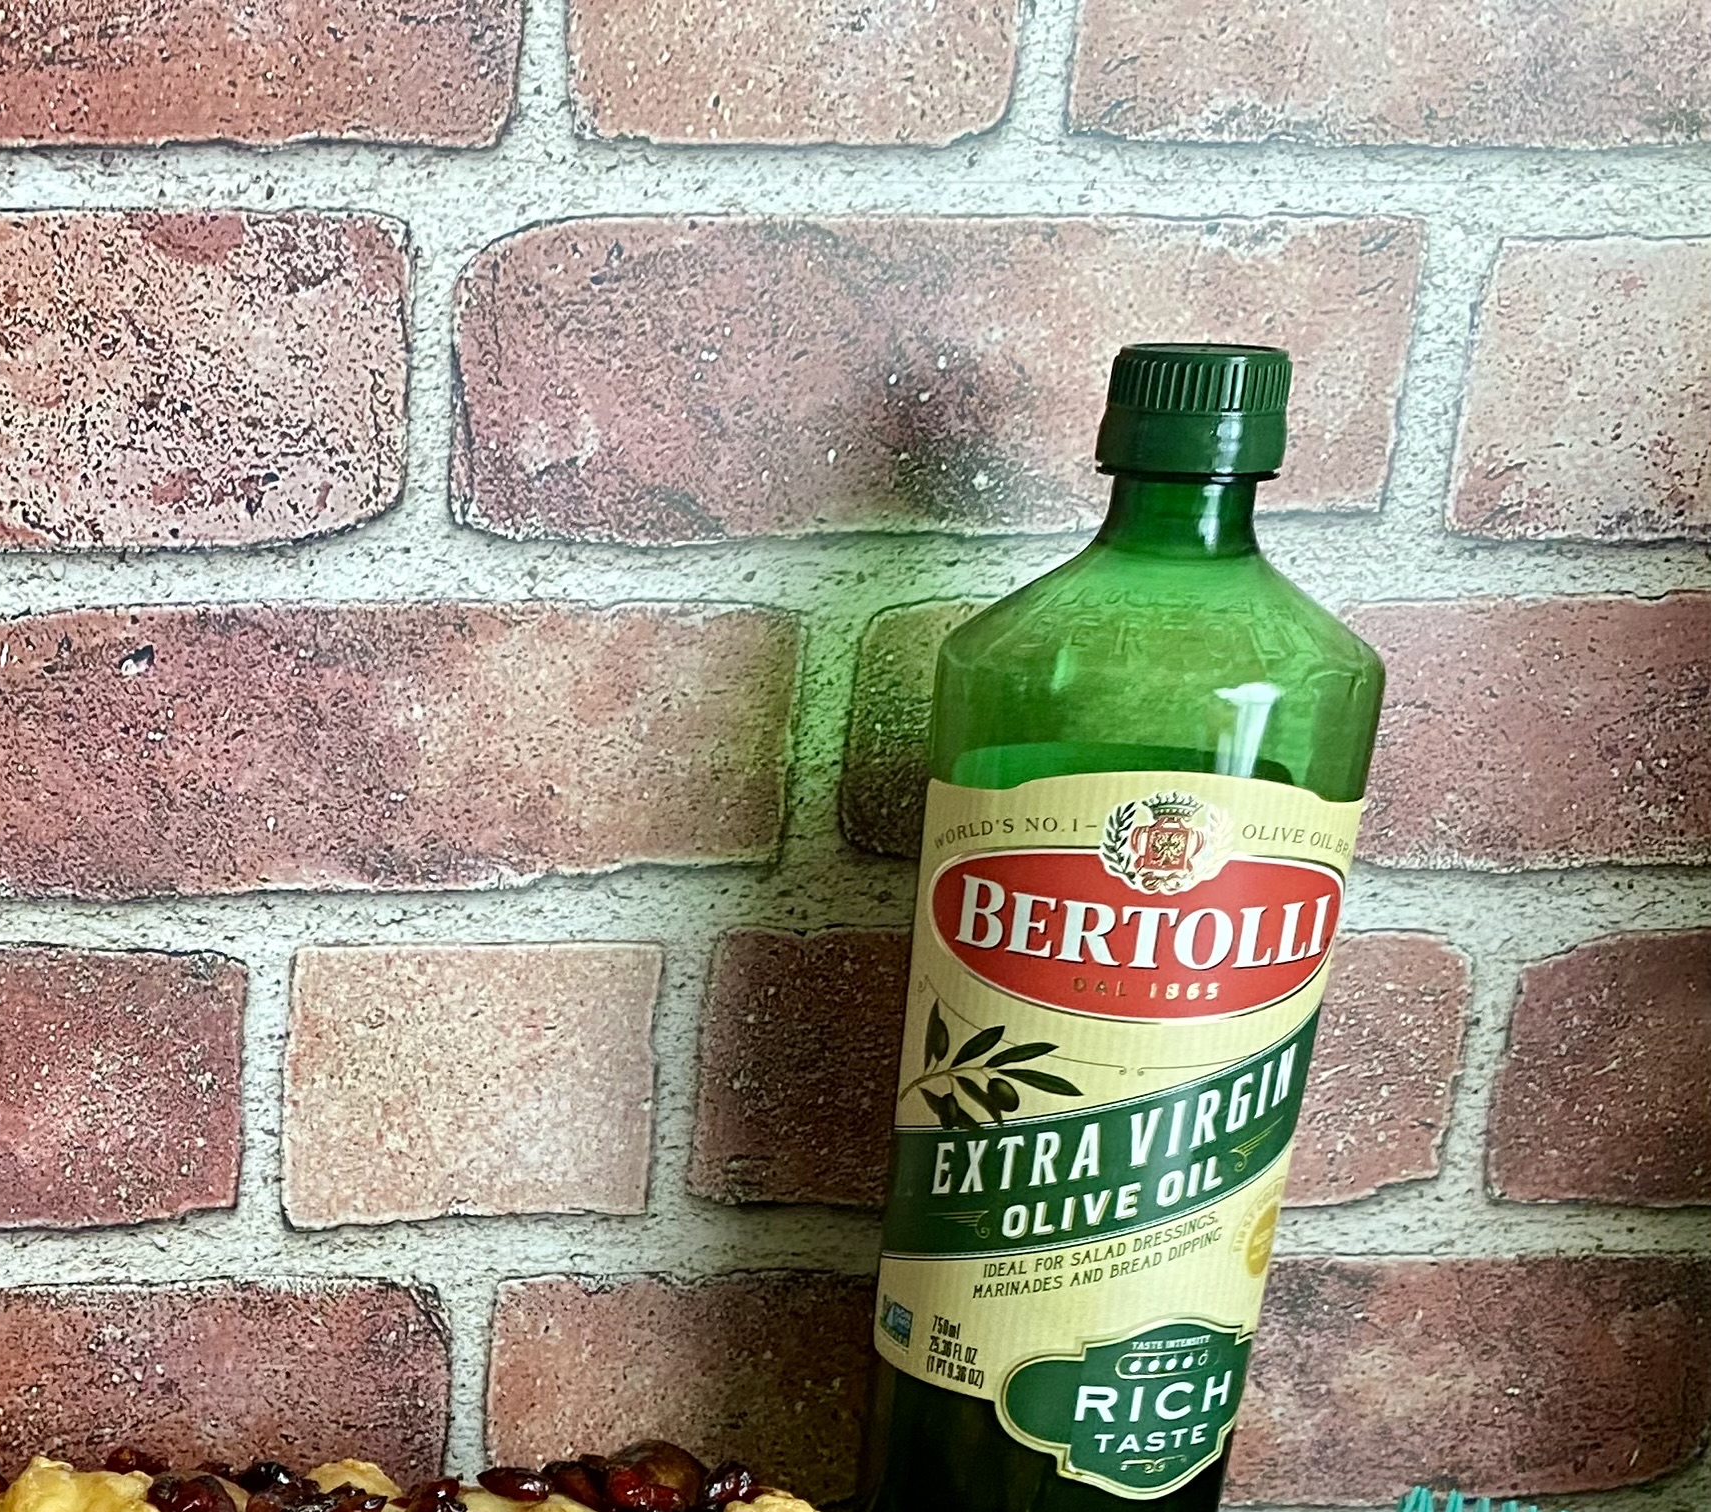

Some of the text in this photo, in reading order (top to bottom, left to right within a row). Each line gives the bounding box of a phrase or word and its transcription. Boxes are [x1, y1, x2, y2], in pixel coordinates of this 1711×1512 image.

[934, 817, 1014, 850] WORLD'S
[1242, 824, 1306, 844] OLIVE
[1310, 831, 1333, 850] OIL
[955, 874, 1333, 970] BERTOLLI
[1073, 977, 1221, 1001] DAL 1865
[931, 1043, 1298, 1195] EXTRA VIRGIN
[1001, 1156, 1224, 1239] OLIVE OIL
[972, 1275, 1063, 1299] MARINADES
[1070, 1268, 1104, 1288] AND
[1110, 1252, 1162, 1277] BREAD
[1168, 1226, 1223, 1261] DIPPING
[983, 1260, 1027, 1279] IDEAL
[1034, 1255, 1064, 1272] FOR
[1070, 1242, 1127, 1267] SALAD
[953, 1343, 963, 1362] FL
[965, 1346, 979, 1365] OZ
[1132, 1334, 1211, 1350] TASTE INTENSITY
[936, 1358, 947, 1376] PT
[968, 1368, 985, 1389] OZ)
[1074, 1370, 1232, 1423] RICH
[1094, 1423, 1208, 1454] TASTE
